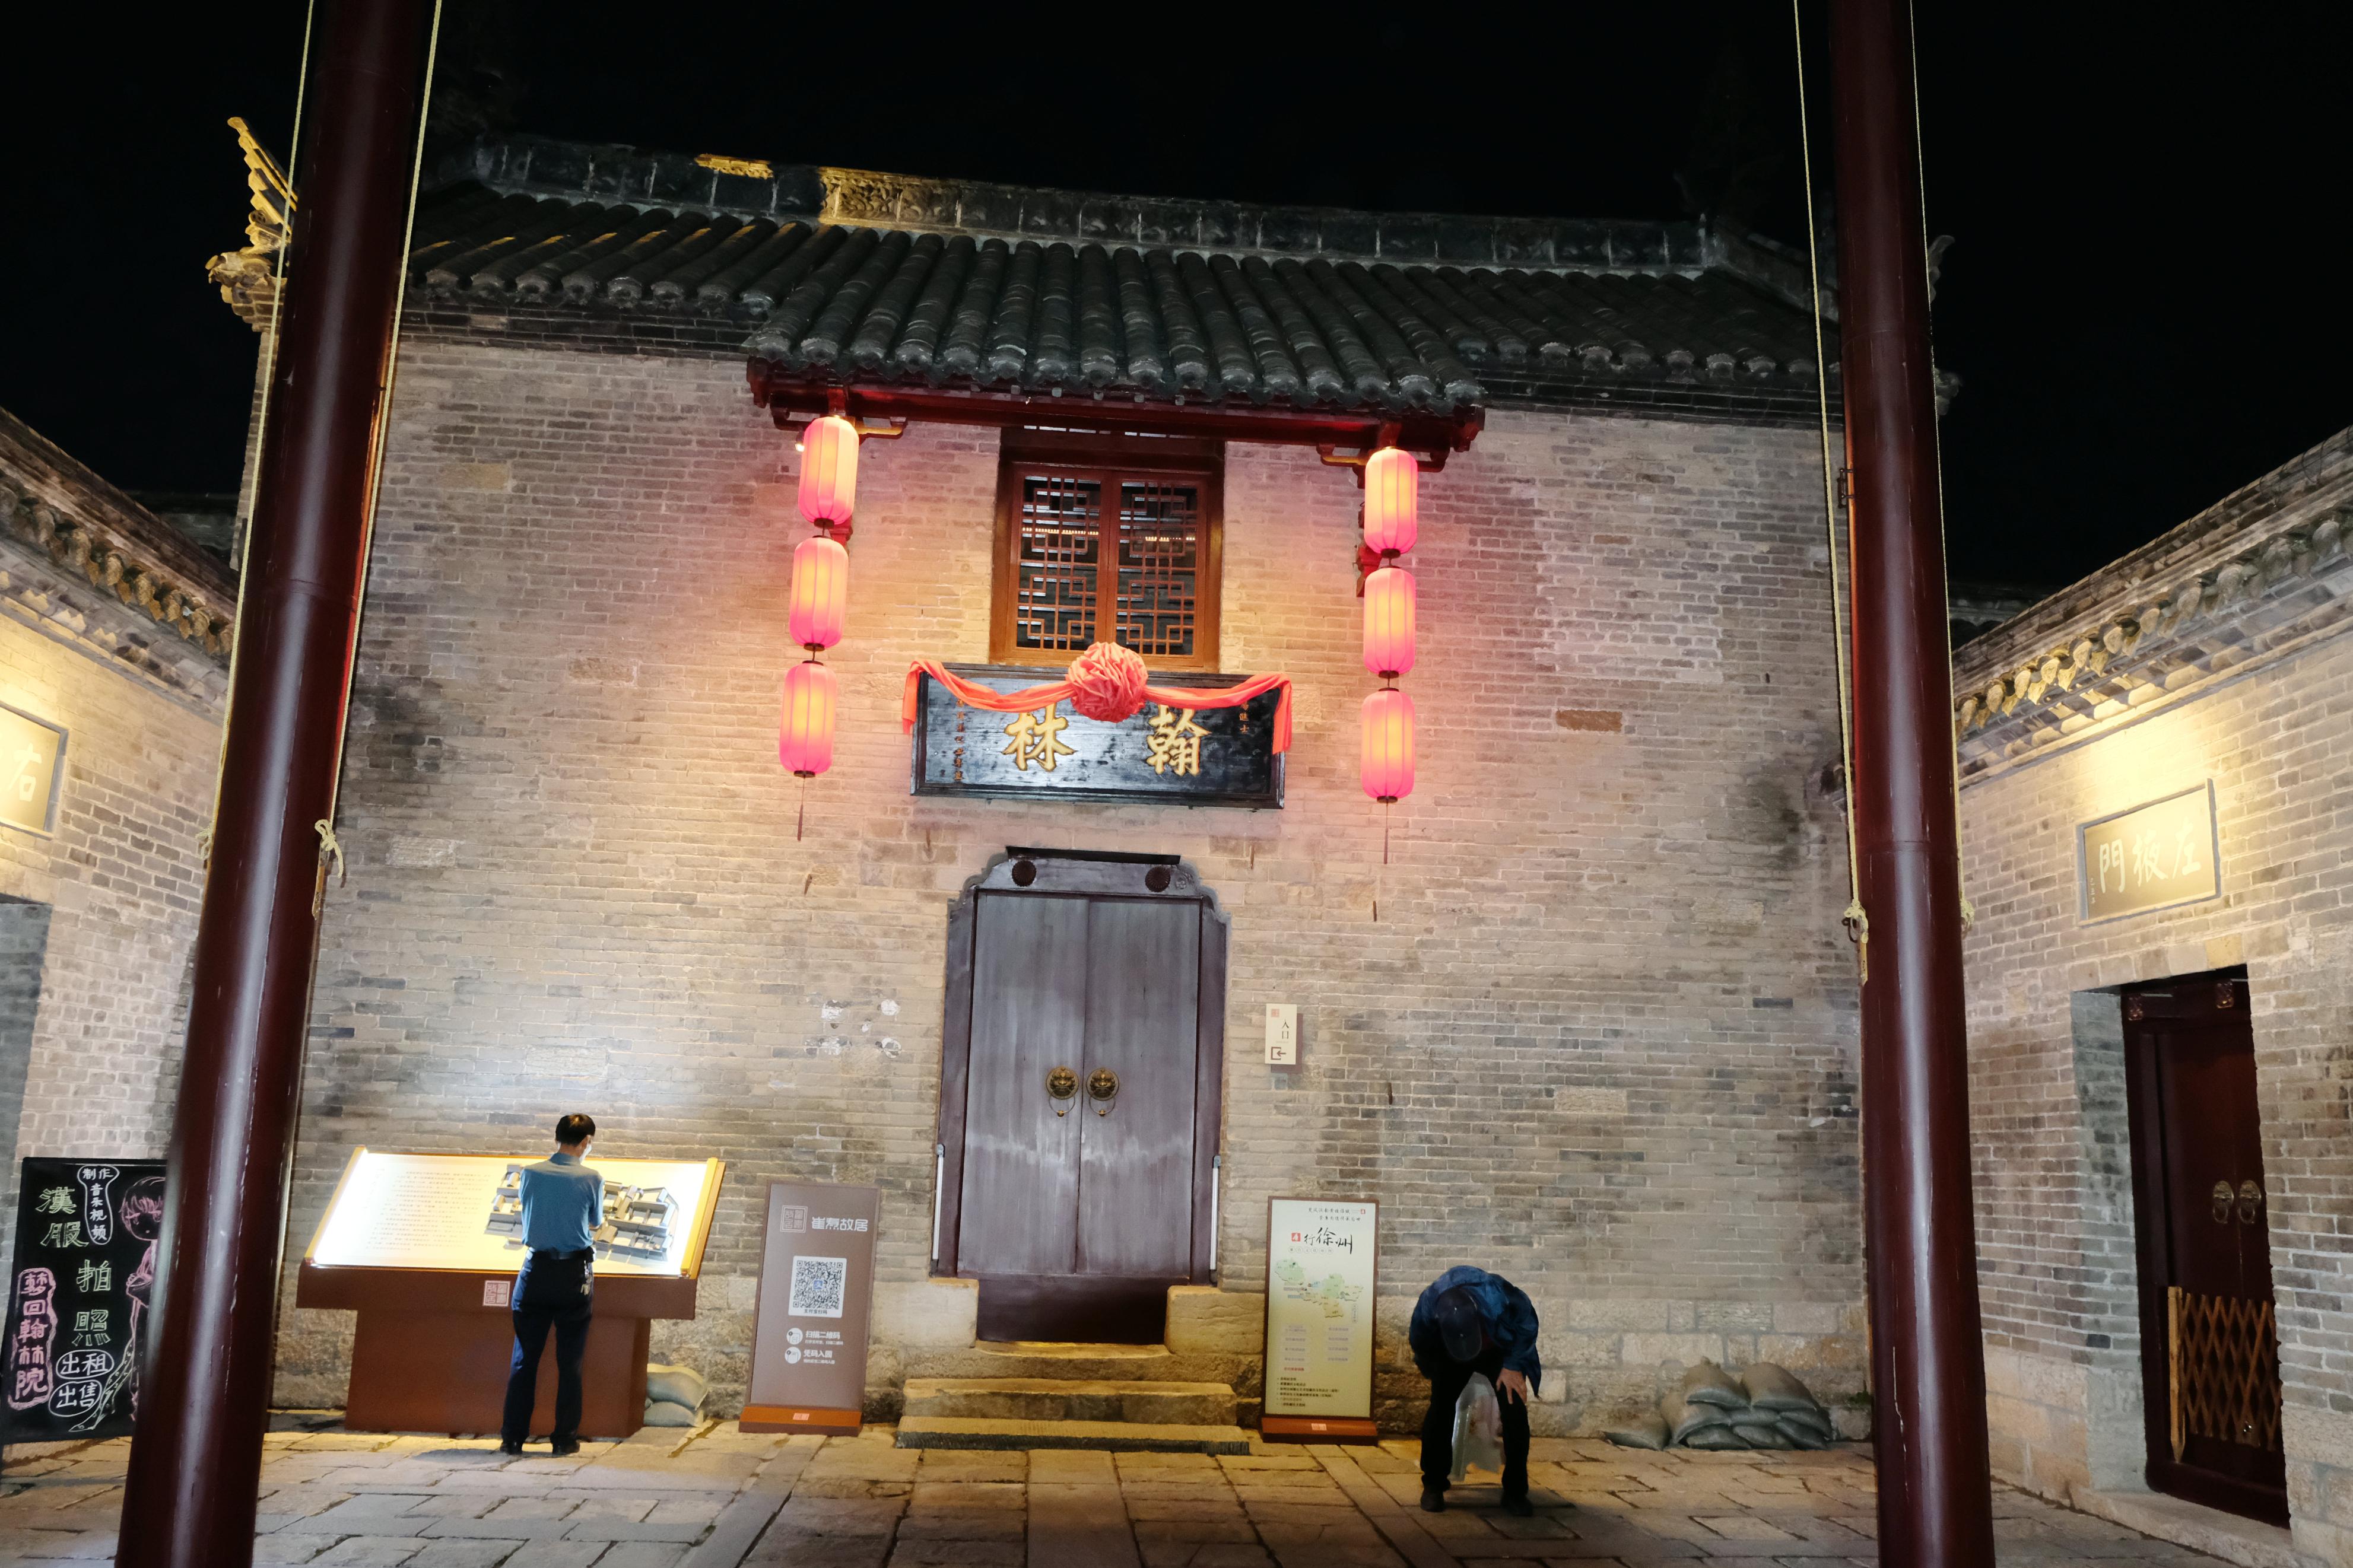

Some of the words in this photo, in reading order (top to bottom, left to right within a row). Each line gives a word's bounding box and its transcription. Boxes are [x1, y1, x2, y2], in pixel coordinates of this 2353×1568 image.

[8, 742, 42, 802] 右
[2099, 816, 2201, 894] 左掖門
[1281, 1019, 1290, 1039] 入口
[82, 1168, 114, 1180] 制作
[35, 1186, 90, 1248] 漢服
[89, 1182, 108, 1241] 音乐视频
[71, 1259, 112, 1347] 拍照
[14, 1271, 49, 1400] 梦回翰林院
[60, 1353, 109, 1376] 出租
[805, 1330, 840, 1340] 扫描二维码
[56, 1382, 99, 1409] 出售
